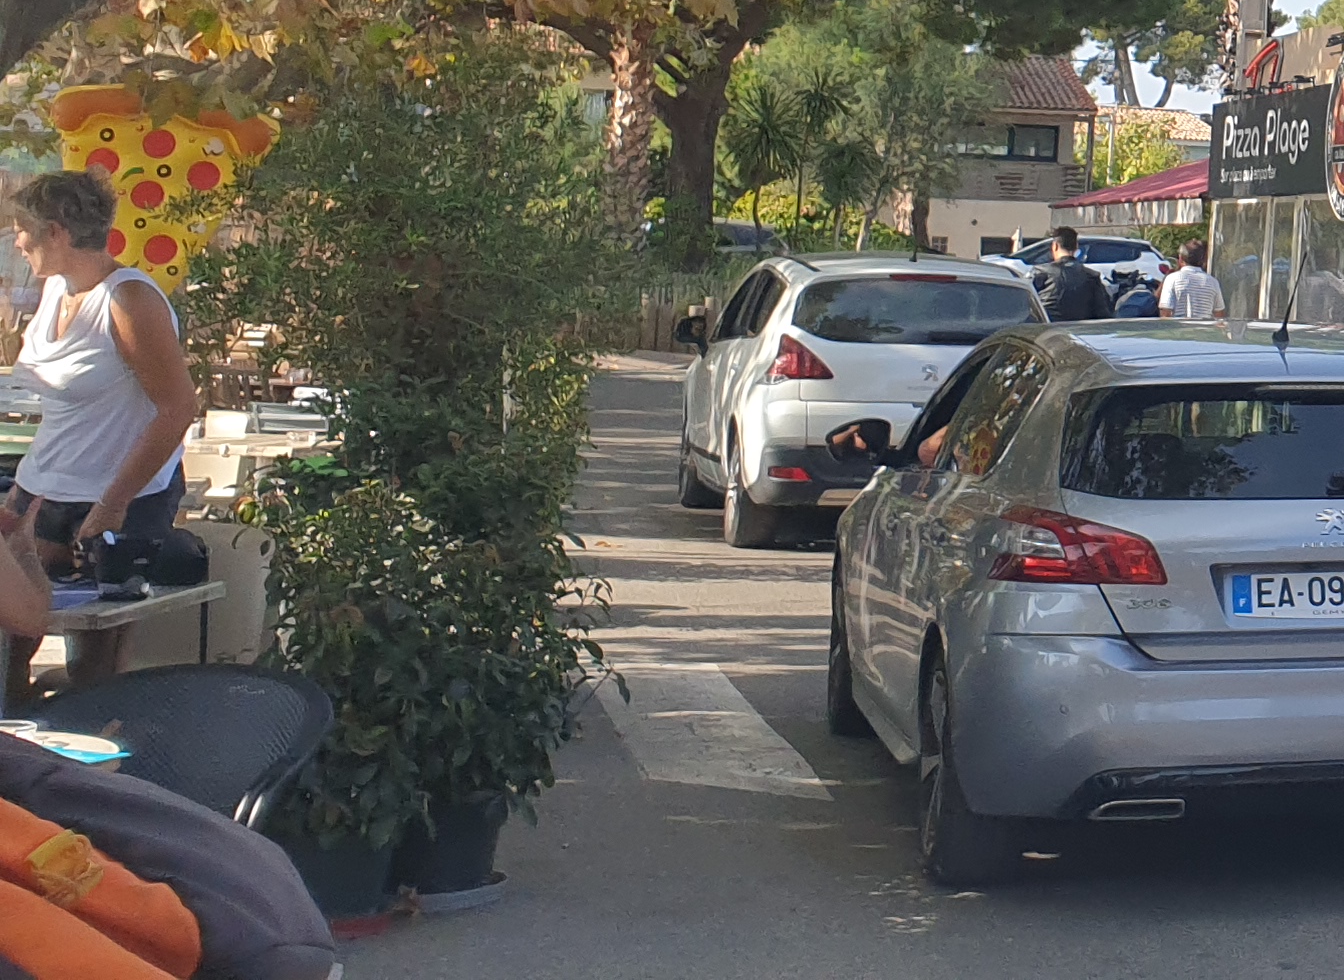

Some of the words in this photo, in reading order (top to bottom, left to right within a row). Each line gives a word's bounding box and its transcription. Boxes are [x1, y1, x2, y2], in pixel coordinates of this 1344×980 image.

[1222, 115, 1260, 160] Pizza
[1264, 107, 1310, 165] Plage
[1239, 598, 1247, 607] F
